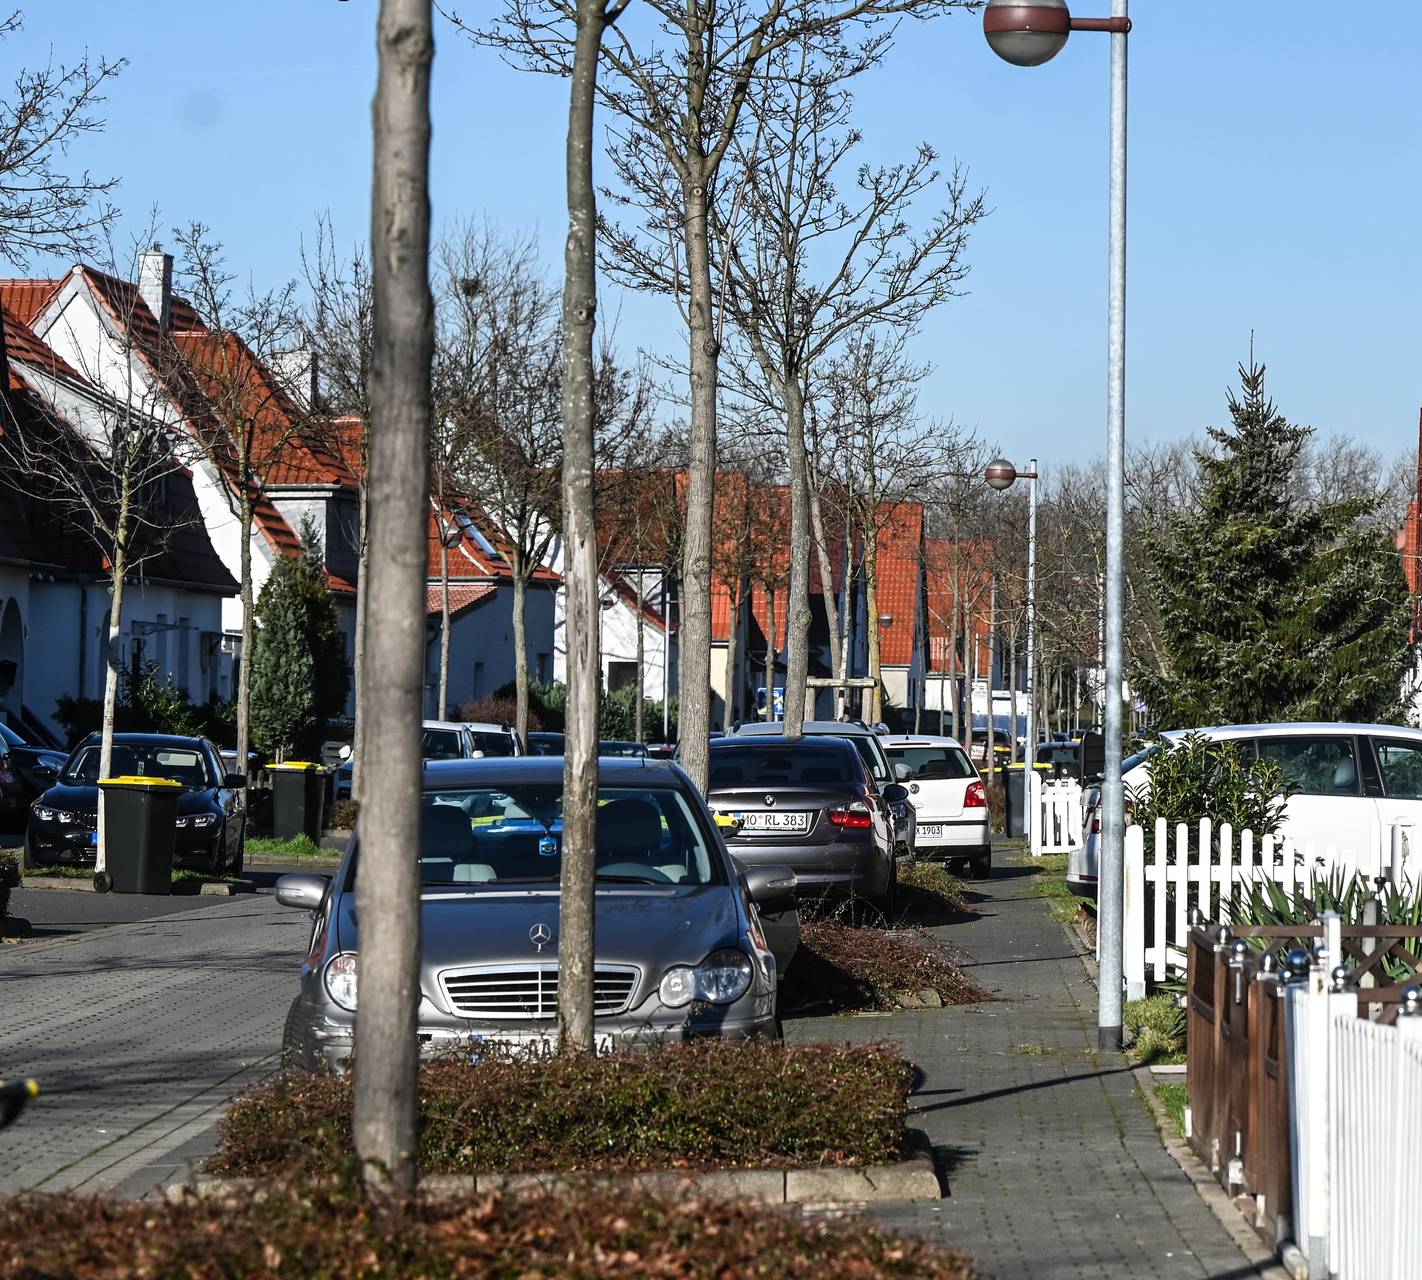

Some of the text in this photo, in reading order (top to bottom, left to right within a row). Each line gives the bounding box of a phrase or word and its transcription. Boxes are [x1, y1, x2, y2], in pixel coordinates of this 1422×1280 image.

[765, 814, 780, 826] RL
[782, 814, 805, 826] 383
[922, 826, 941, 835] 1903
